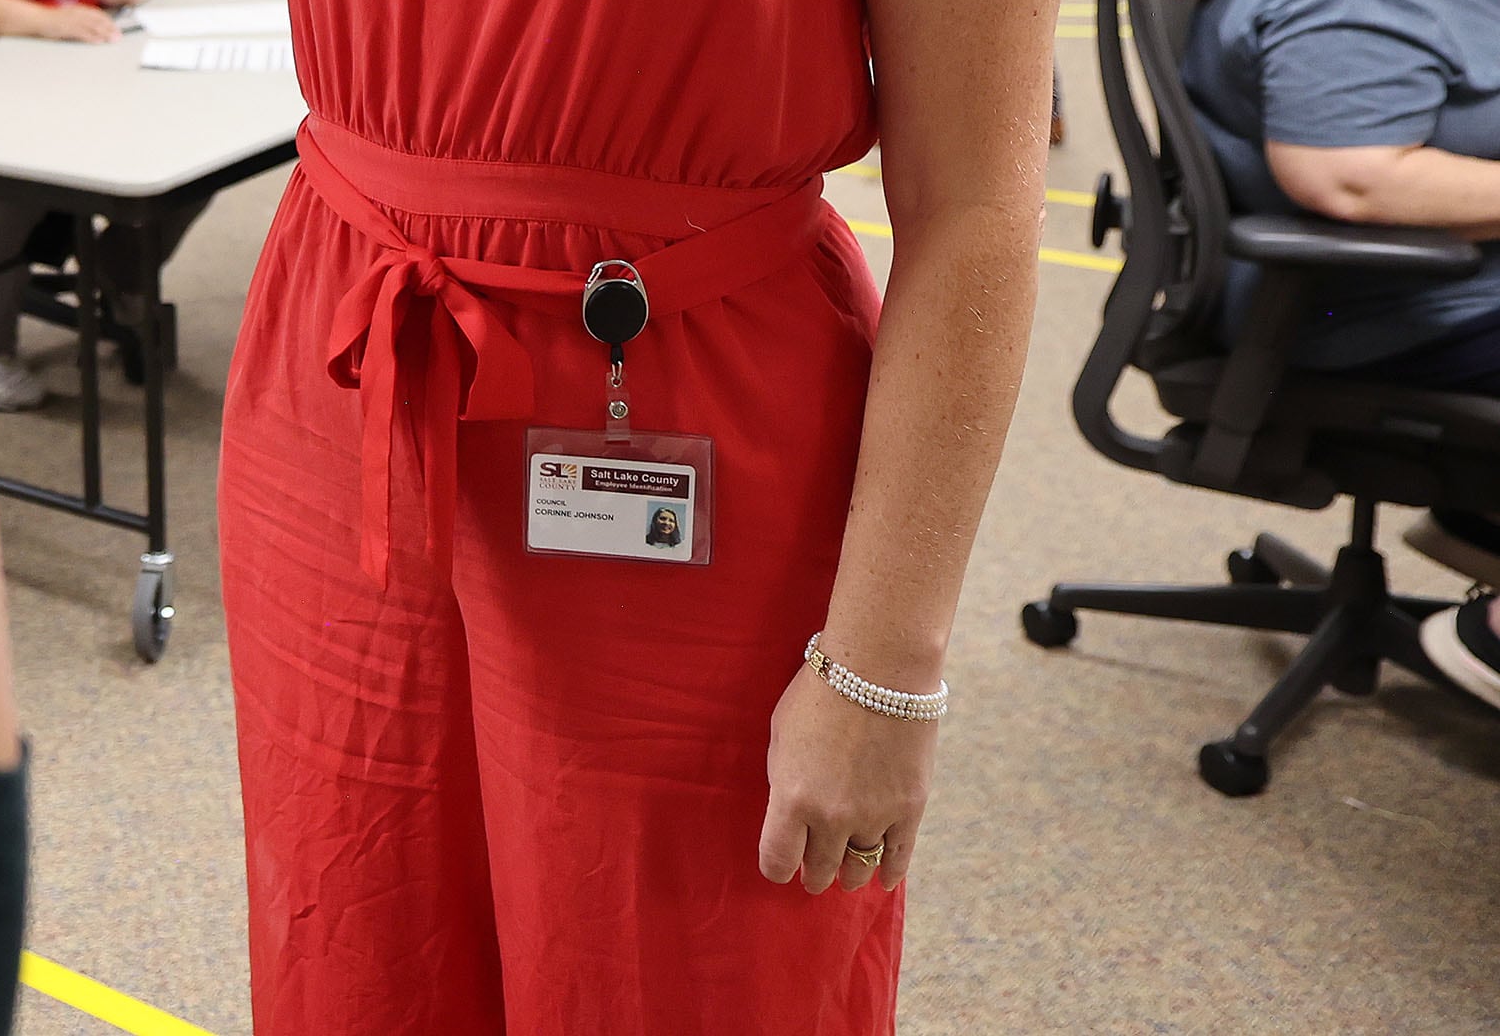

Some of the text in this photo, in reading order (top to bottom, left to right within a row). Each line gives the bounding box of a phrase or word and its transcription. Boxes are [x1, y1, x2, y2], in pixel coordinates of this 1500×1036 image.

[540, 462, 568, 478] SL
[591, 469, 679, 486] Salt Lake County
[539, 483, 577, 491] COUNTY
[595, 480, 672, 492] Employee Identification
[537, 498, 567, 506] COUNCIL
[535, 509, 614, 521] CORINNE JOHNSON
